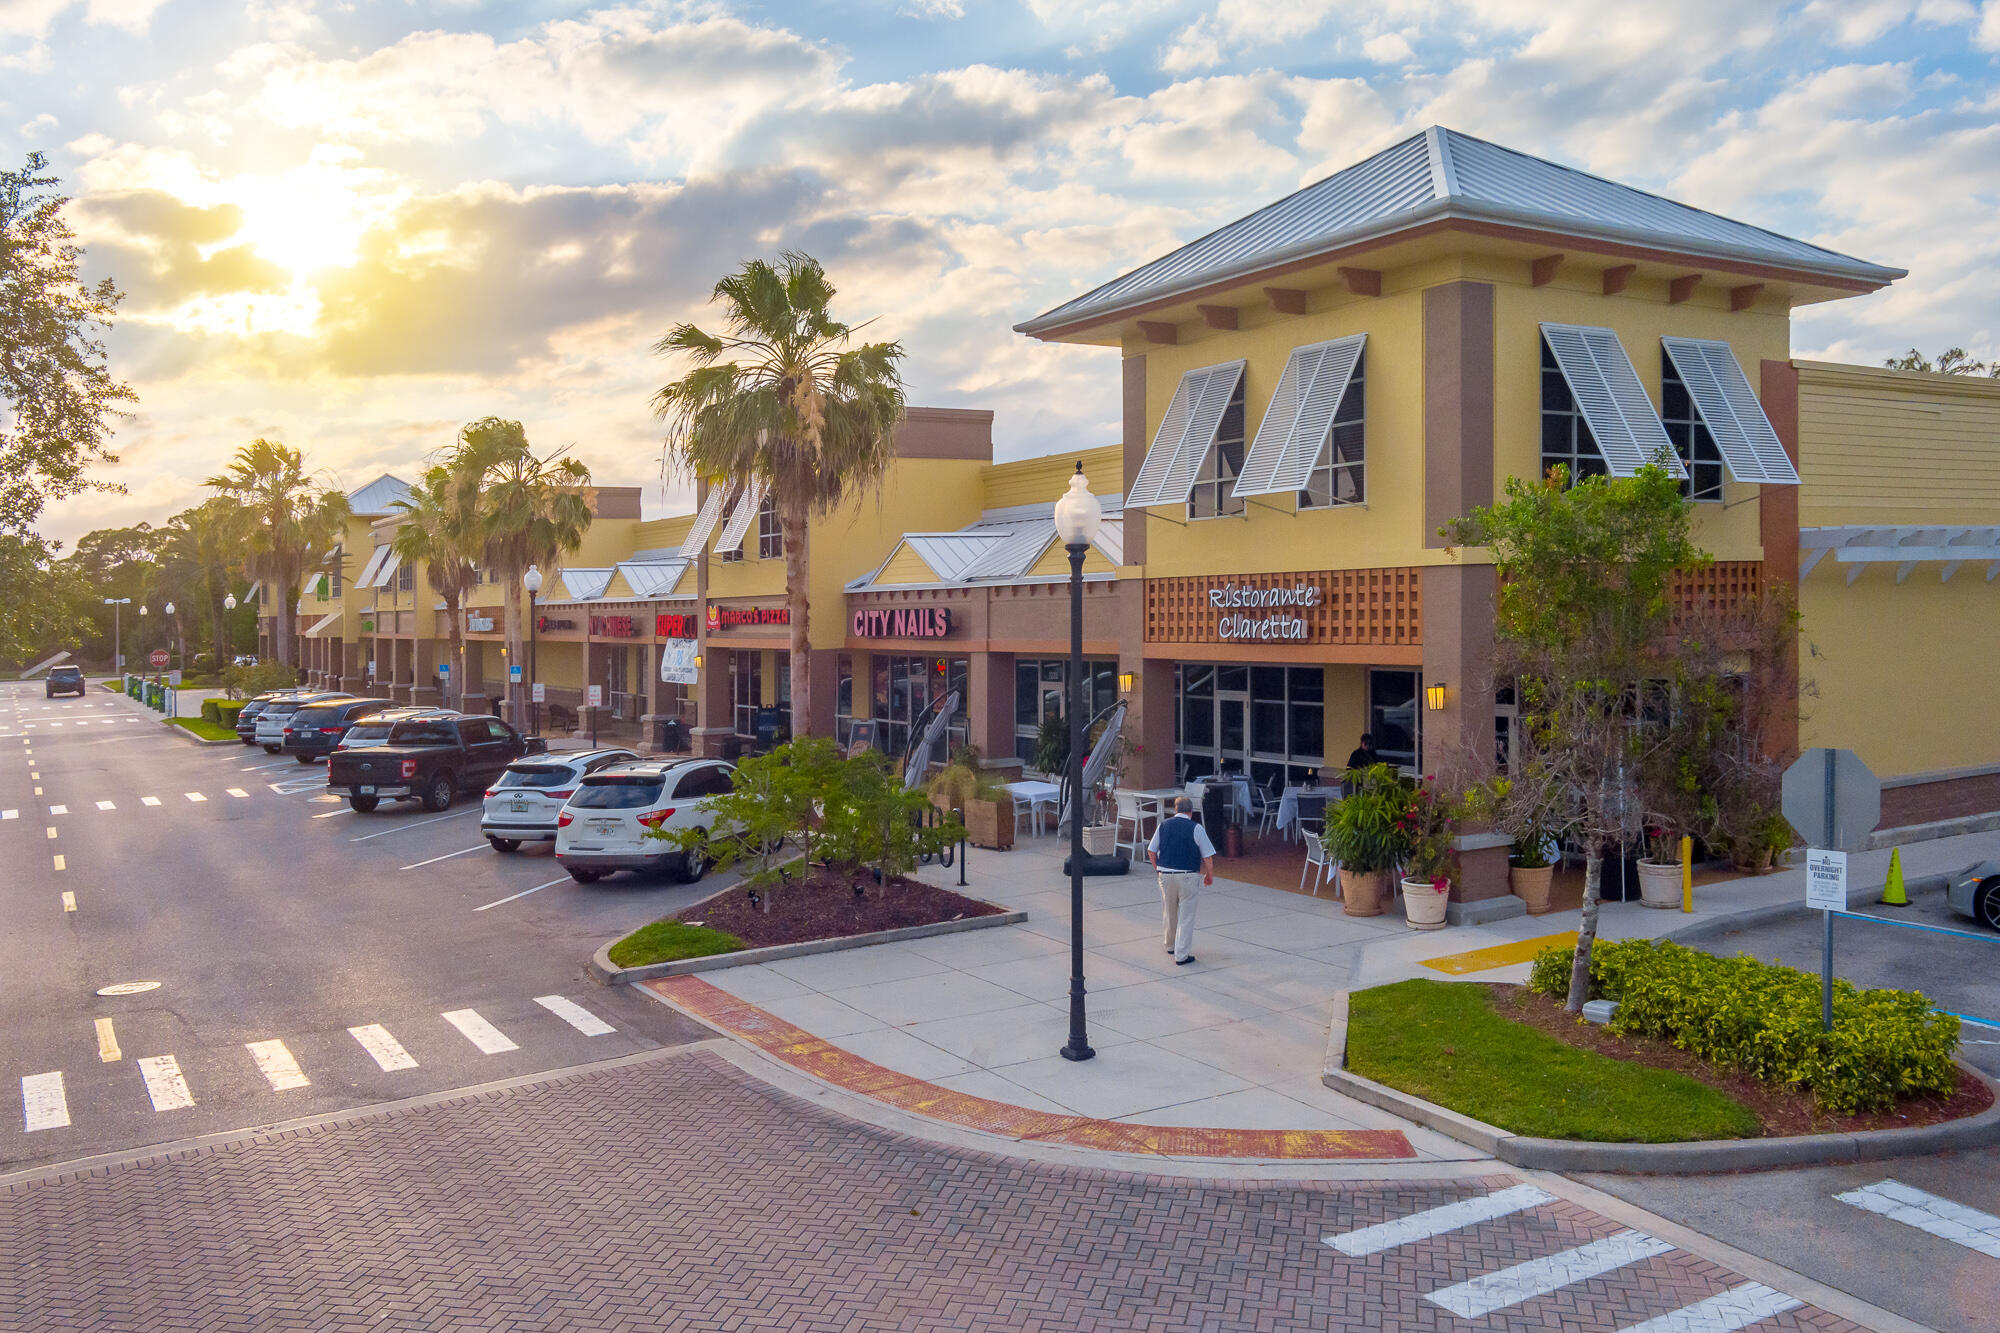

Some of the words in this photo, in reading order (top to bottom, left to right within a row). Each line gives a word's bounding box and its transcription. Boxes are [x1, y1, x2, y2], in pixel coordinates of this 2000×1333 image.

[1208, 583, 1314, 608] Ristorante
[656, 614, 698, 638] SUPERCU
[721, 606, 759, 625] MARCO'S
[761, 609, 788, 625] PIZZA
[853, 609, 891, 637] CITY
[894, 607, 947, 637] NAILS
[1219, 613, 1302, 640] Claretta
[1809, 864, 1842, 874] OVERNIGHT
[1813, 872, 1840, 881] PARKING
